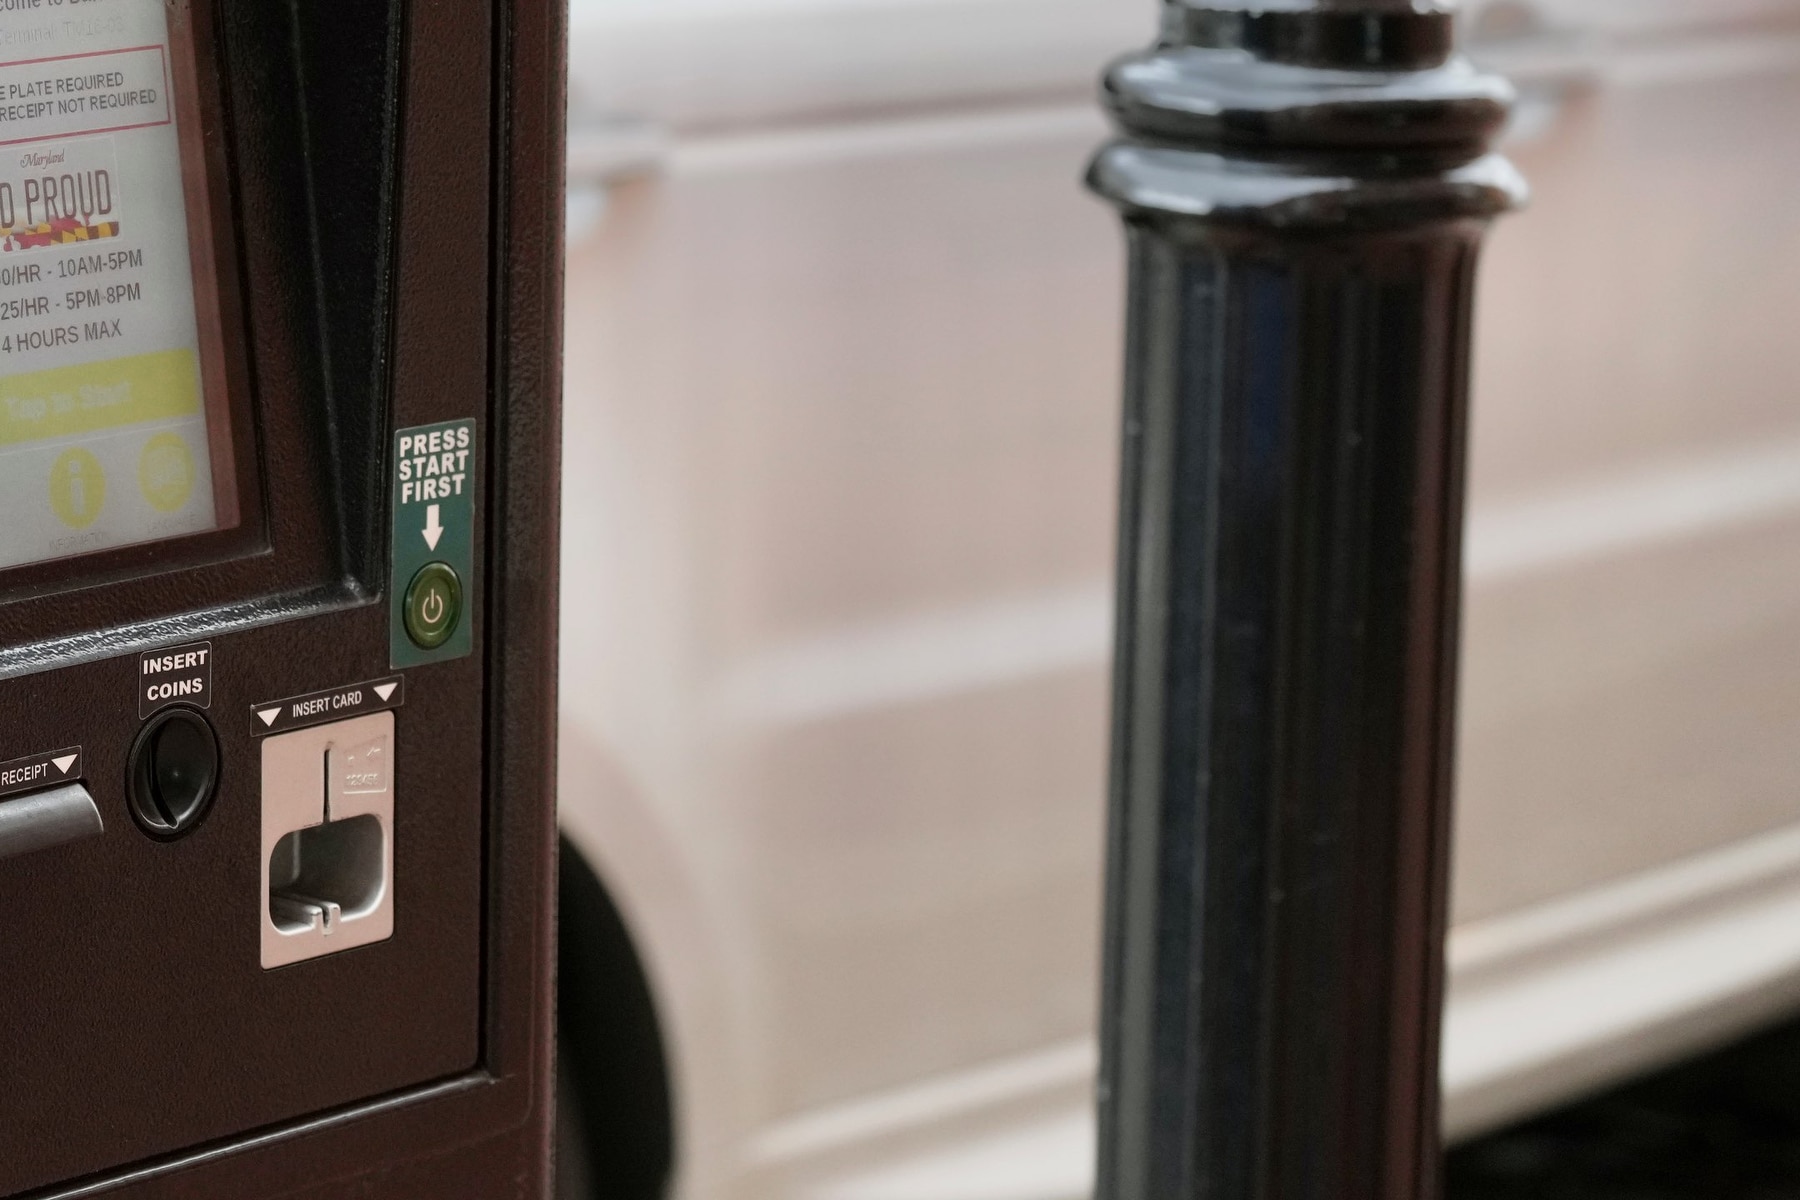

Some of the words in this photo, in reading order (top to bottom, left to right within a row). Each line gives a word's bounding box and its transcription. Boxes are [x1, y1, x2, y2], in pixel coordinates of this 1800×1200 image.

[9, 80, 53, 99] PLATE
[56, 71, 124, 94] REQUIRED
[58, 97, 86, 115] NOT
[89, 88, 157, 111] REQUIRED
[19, 148, 65, 170] Maryland
[24, 169, 112, 225] PROUD
[57, 248, 143, 279] 10AM-5PM
[1, 335, 12, 354] 4
[16, 326, 80, 353] HOURS
[84, 318, 123, 341] MAX
[400, 427, 470, 458] PRESS
[399, 449, 469, 481] START
[402, 473, 466, 504] FIRST
[143, 649, 208, 675] INSERT
[147, 677, 203, 701] COINS
[292, 697, 330, 718] INSERT
[332, 690, 362, 709] CARD
[1, 762, 48, 786] RECEIPT
